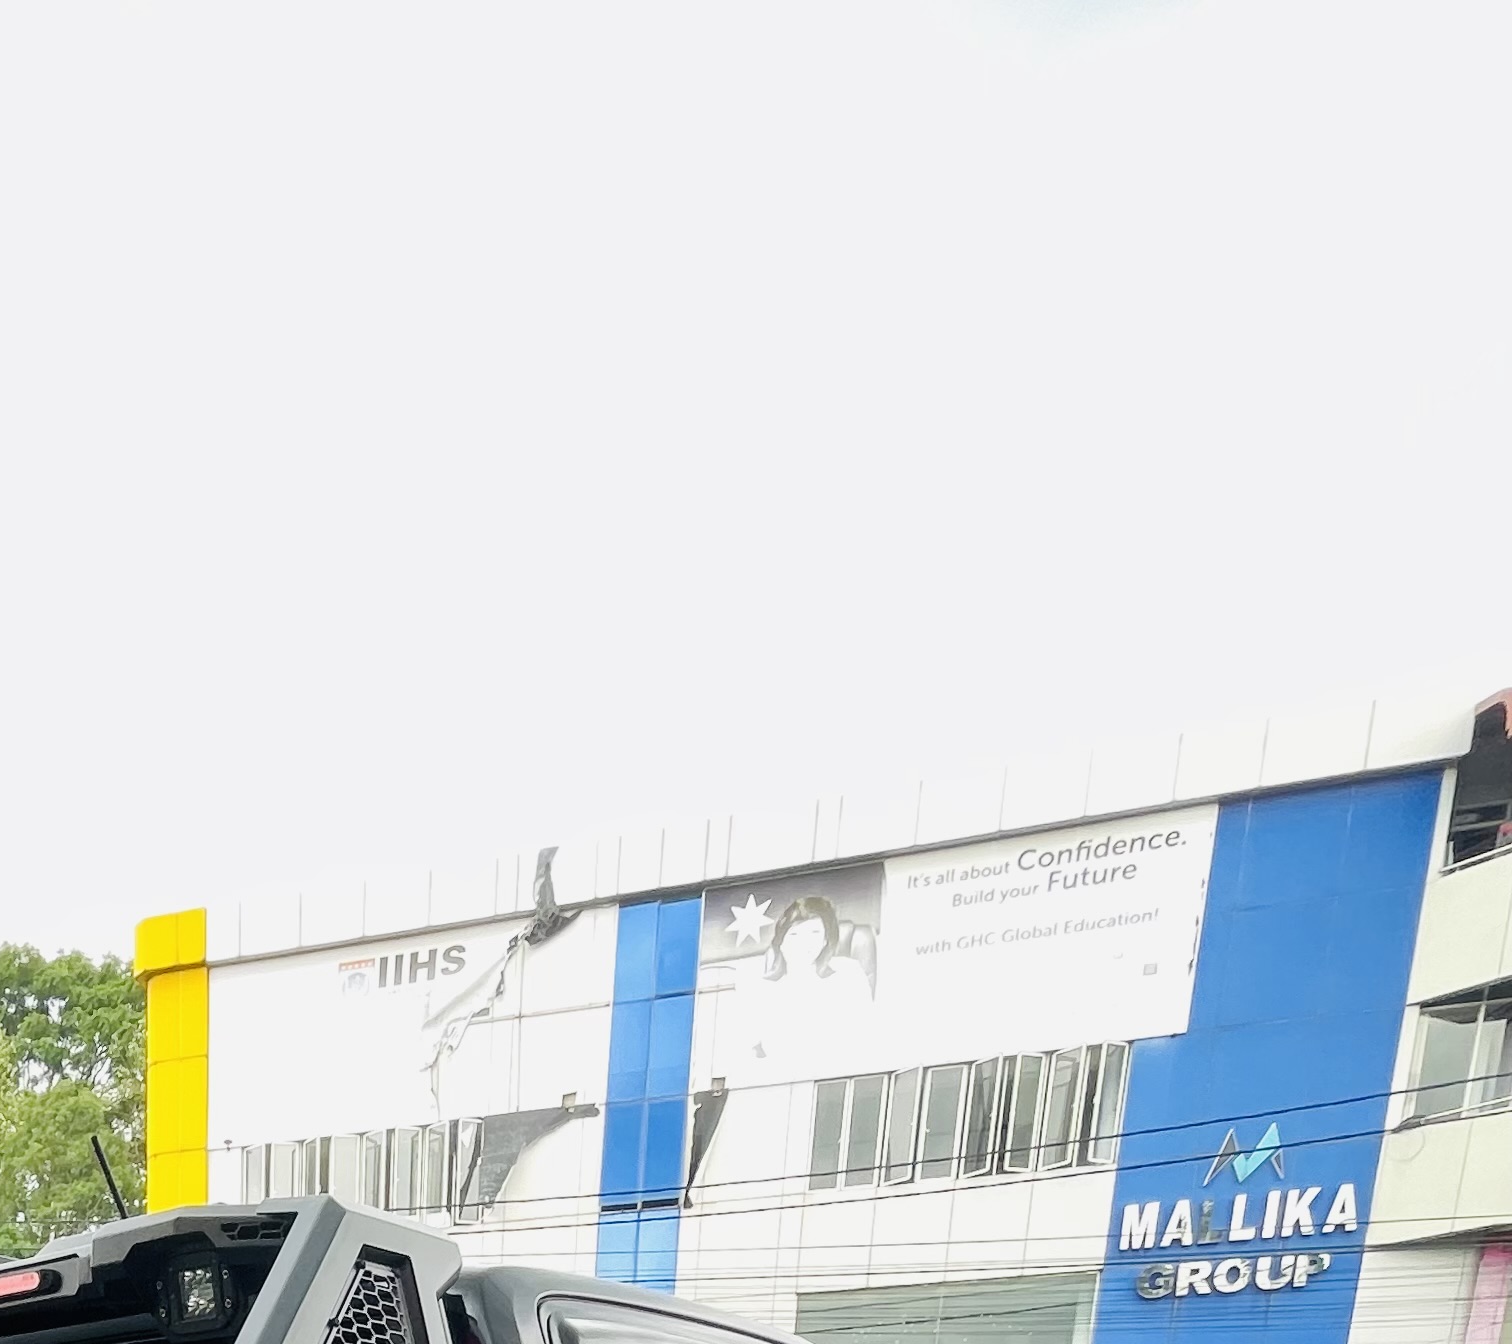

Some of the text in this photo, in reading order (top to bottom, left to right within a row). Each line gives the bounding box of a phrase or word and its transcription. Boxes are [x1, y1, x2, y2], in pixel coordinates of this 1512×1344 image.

[907, 830, 1187, 889] It's all about Confidence.
[952, 863, 1138, 907] Build your Future
[915, 908, 1160, 955] with GHC Global Education!
[378, 944, 466, 988] IIHS
[1136, 1253, 1332, 1299] GROUP
